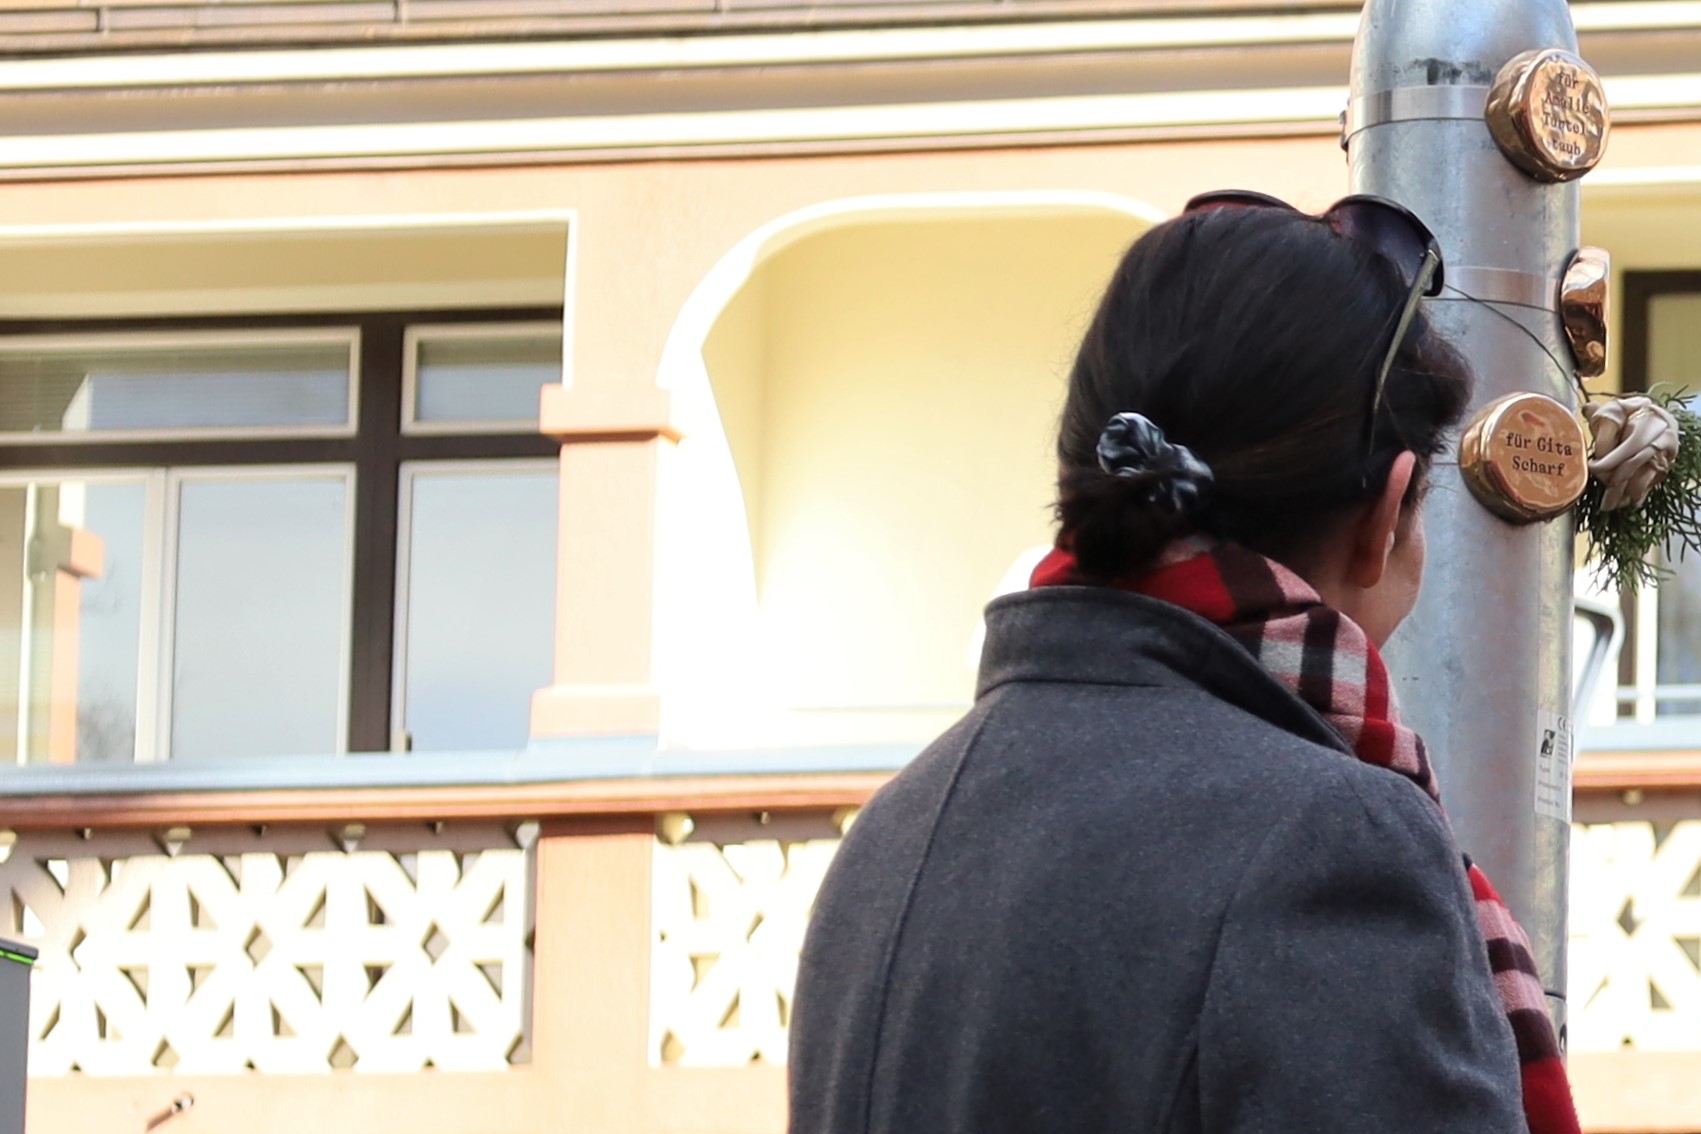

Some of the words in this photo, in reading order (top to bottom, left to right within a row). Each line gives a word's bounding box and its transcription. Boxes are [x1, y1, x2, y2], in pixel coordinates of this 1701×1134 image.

[1506, 432, 1531, 449] für
[1537, 436, 1572, 456] Gita
[1512, 455, 1565, 476] Scharf
